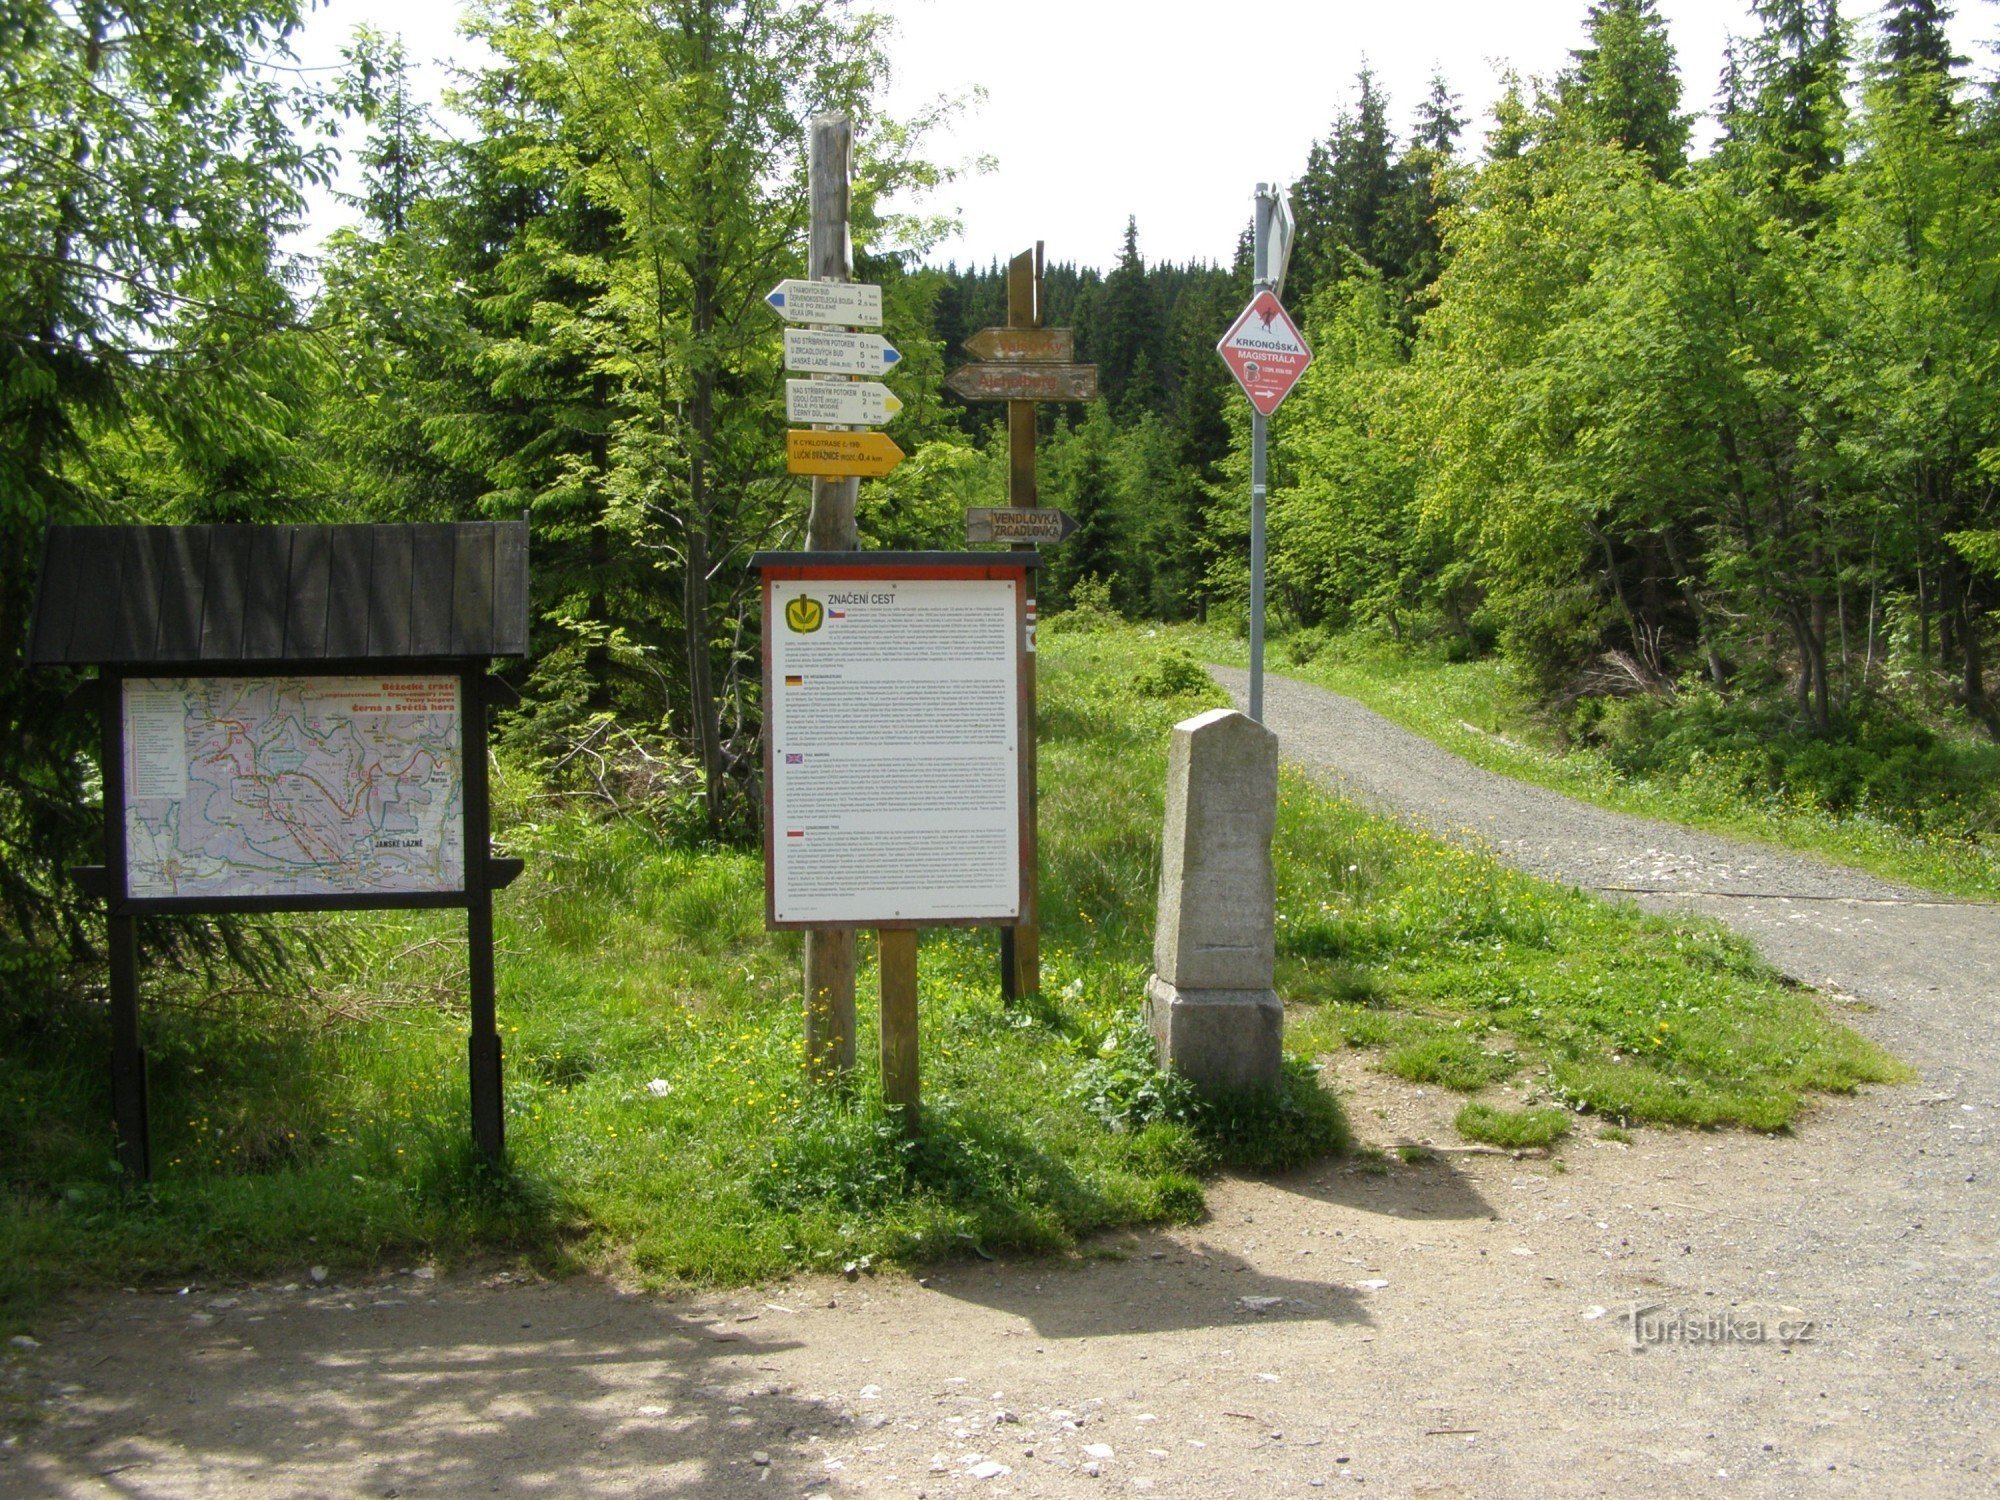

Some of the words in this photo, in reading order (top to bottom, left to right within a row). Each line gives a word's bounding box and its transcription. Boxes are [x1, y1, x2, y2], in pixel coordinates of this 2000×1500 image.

[831, 339, 855, 347] POTOKEM
[812, 358, 828, 366] LÁZNĚ
[800, 440, 840, 448] CYKLOTRASE
[993, 512, 1059, 524] VENDLOVKA
[994, 525, 1060, 537] ZRCADLOVKA
[828, 592, 869, 604] ZNAČENÍ
[871, 594, 895, 604] CEST
[382, 682, 424, 690] Běžecké
[352, 704, 382, 712] Černá
[395, 704, 427, 712] Světlá
[431, 703, 455, 711] hora
[375, 840, 400, 848] JANSKÉ
[403, 838, 423, 847] LÁZNĚ
